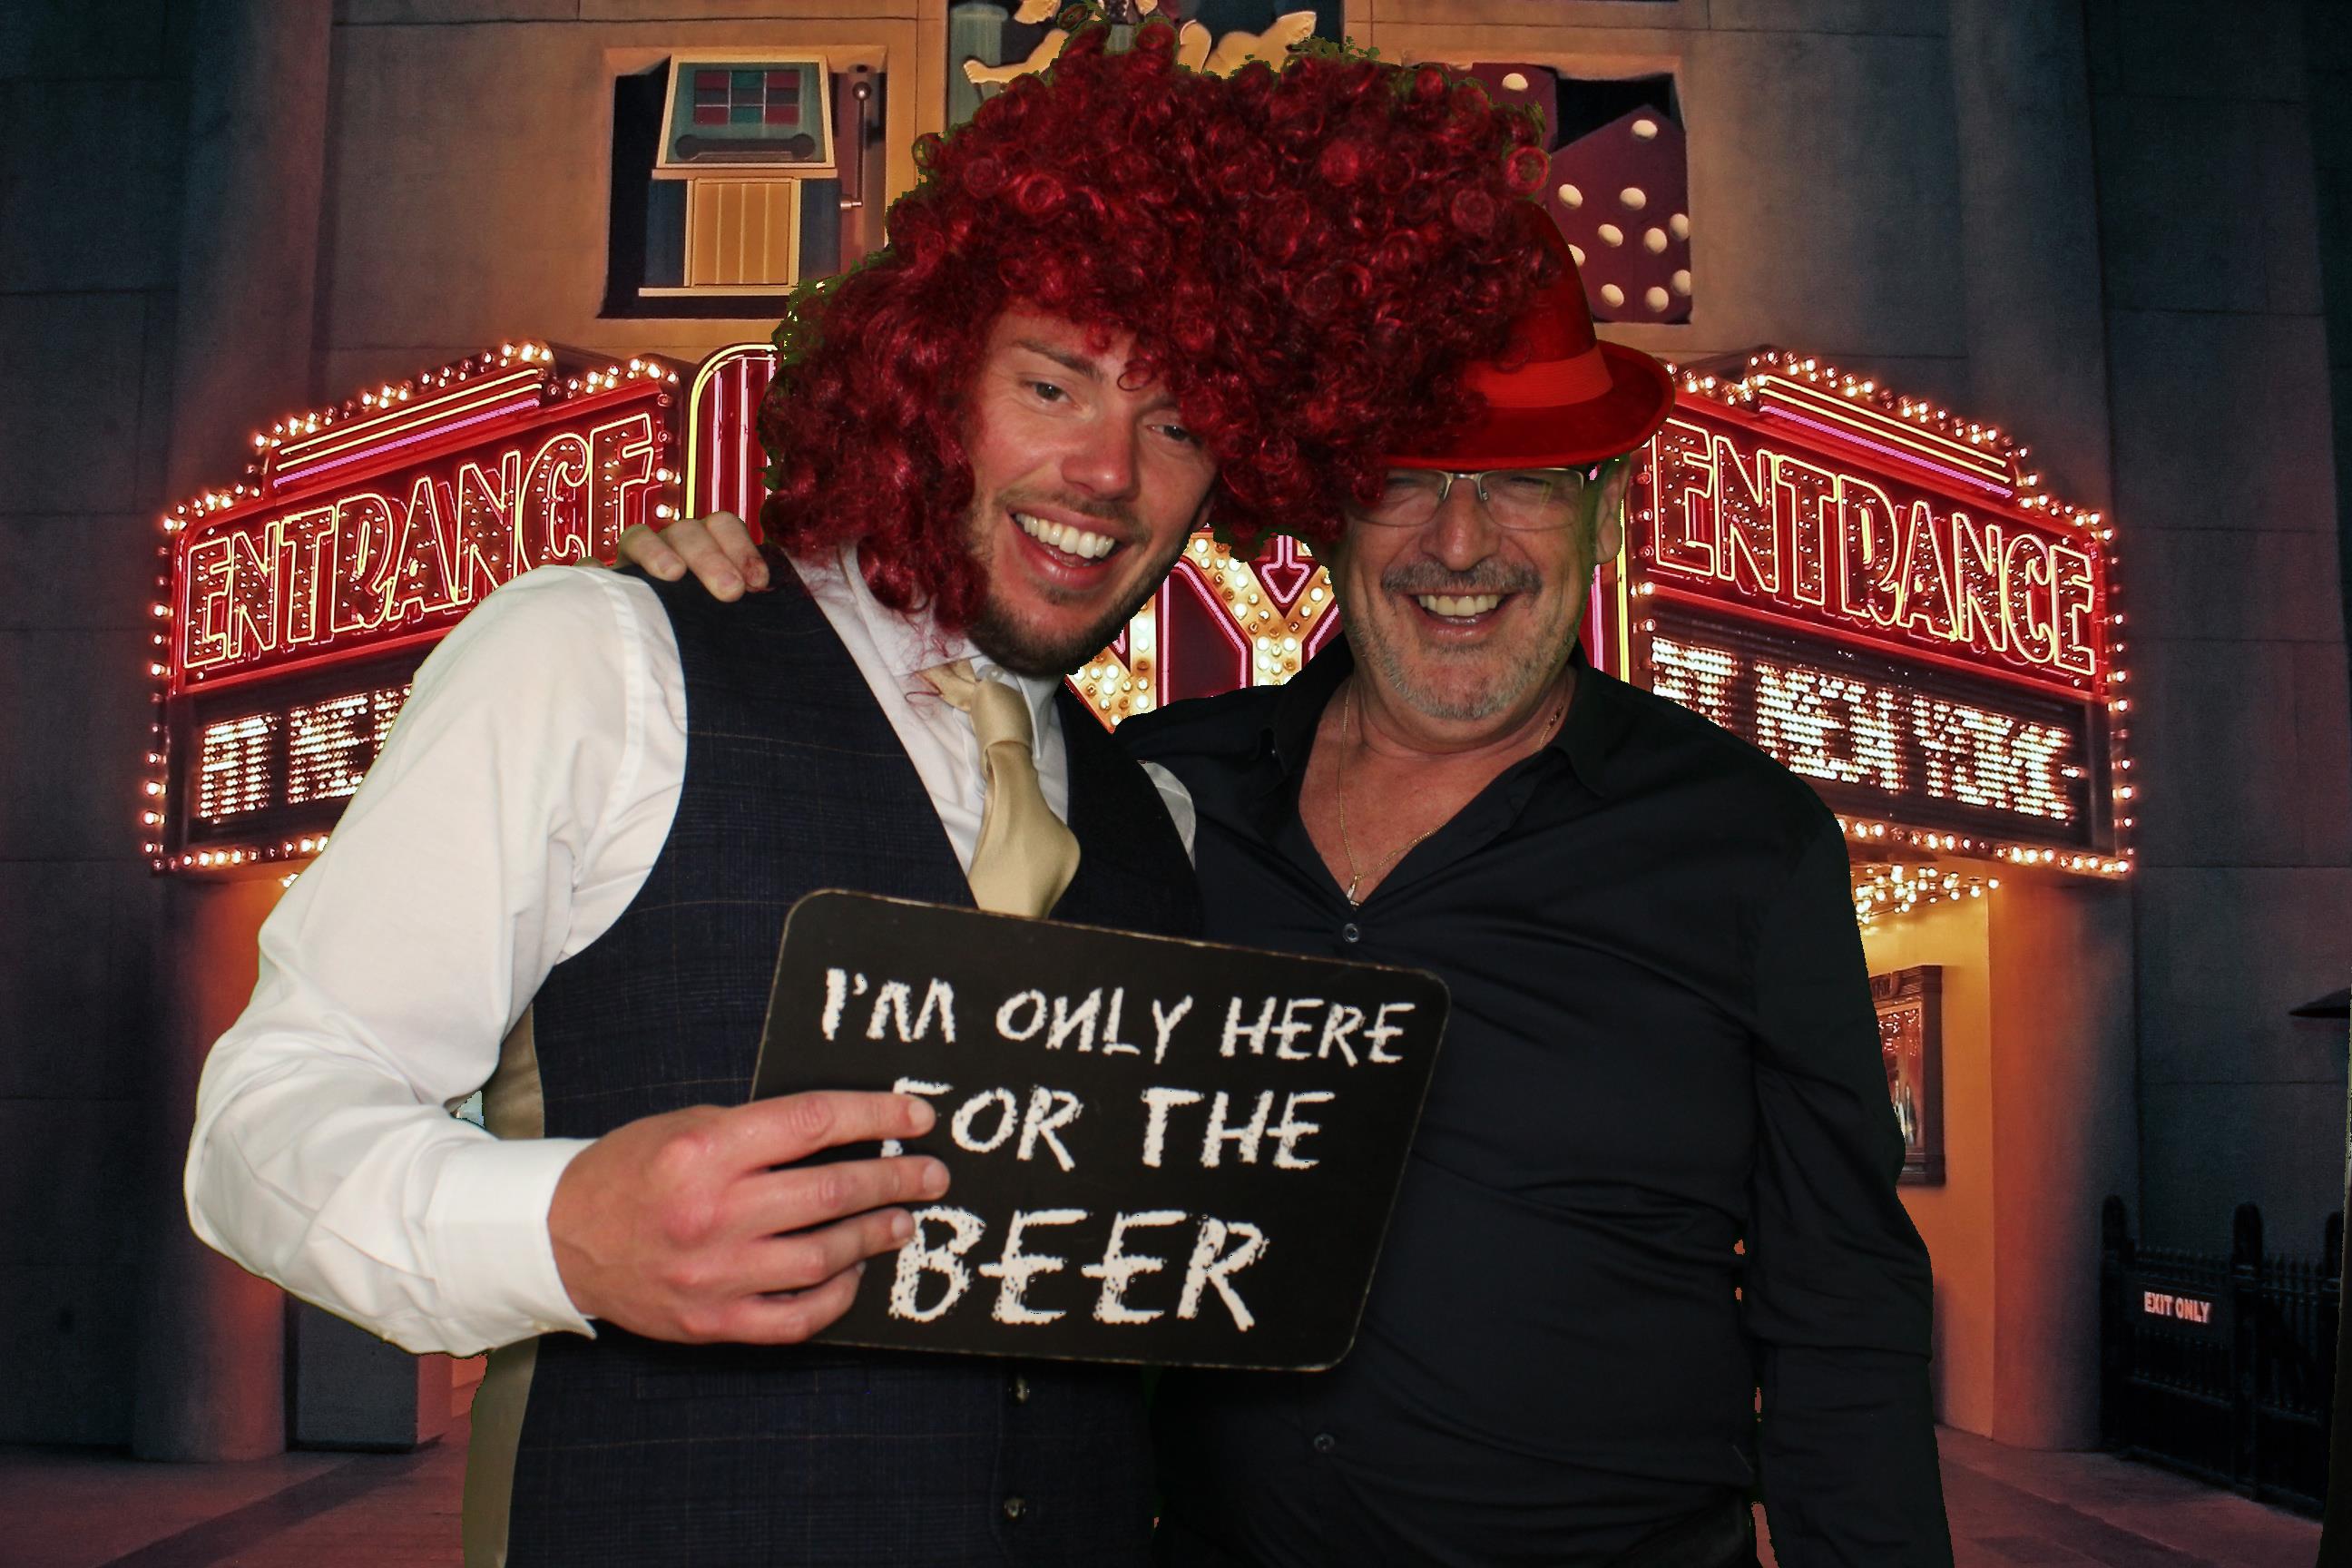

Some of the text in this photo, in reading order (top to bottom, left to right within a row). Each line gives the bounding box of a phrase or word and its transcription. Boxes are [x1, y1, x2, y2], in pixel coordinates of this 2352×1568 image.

[184, 412, 653, 668] ENTRANCE
[1651, 416, 2096, 675] ENTRANCE
[822, 967, 1417, 1067] I'M ONLY HERE
[1139, 1085, 1337, 1170] THE
[887, 1204, 1269, 1332] BEER
[2143, 1290, 2210, 1324] EXIT ONLY
